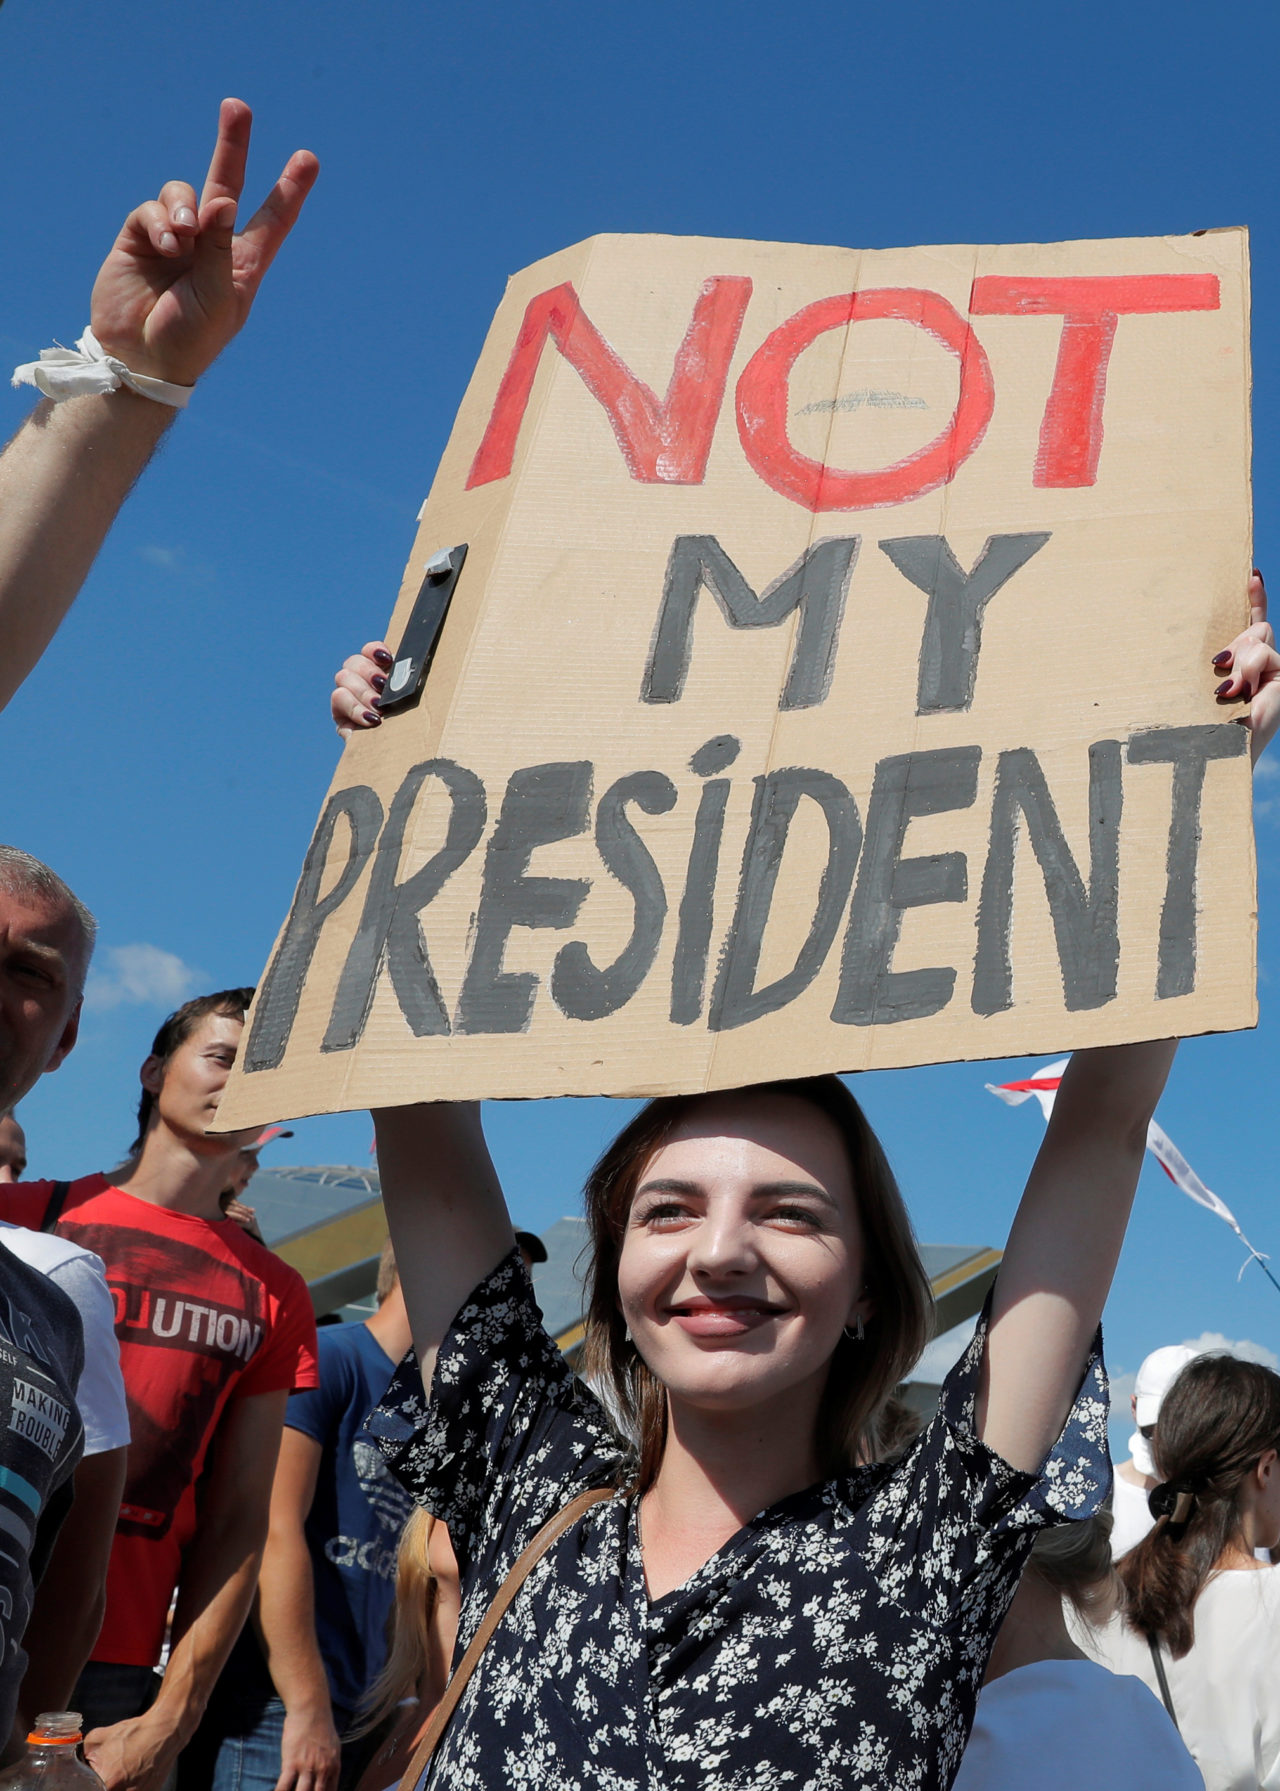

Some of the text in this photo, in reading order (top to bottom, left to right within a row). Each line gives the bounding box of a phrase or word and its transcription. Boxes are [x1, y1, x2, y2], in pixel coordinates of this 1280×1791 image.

[464, 274, 1221, 513] NOT
[639, 531, 1052, 716] MY
[13, 1380, 71, 1431] MAKING
